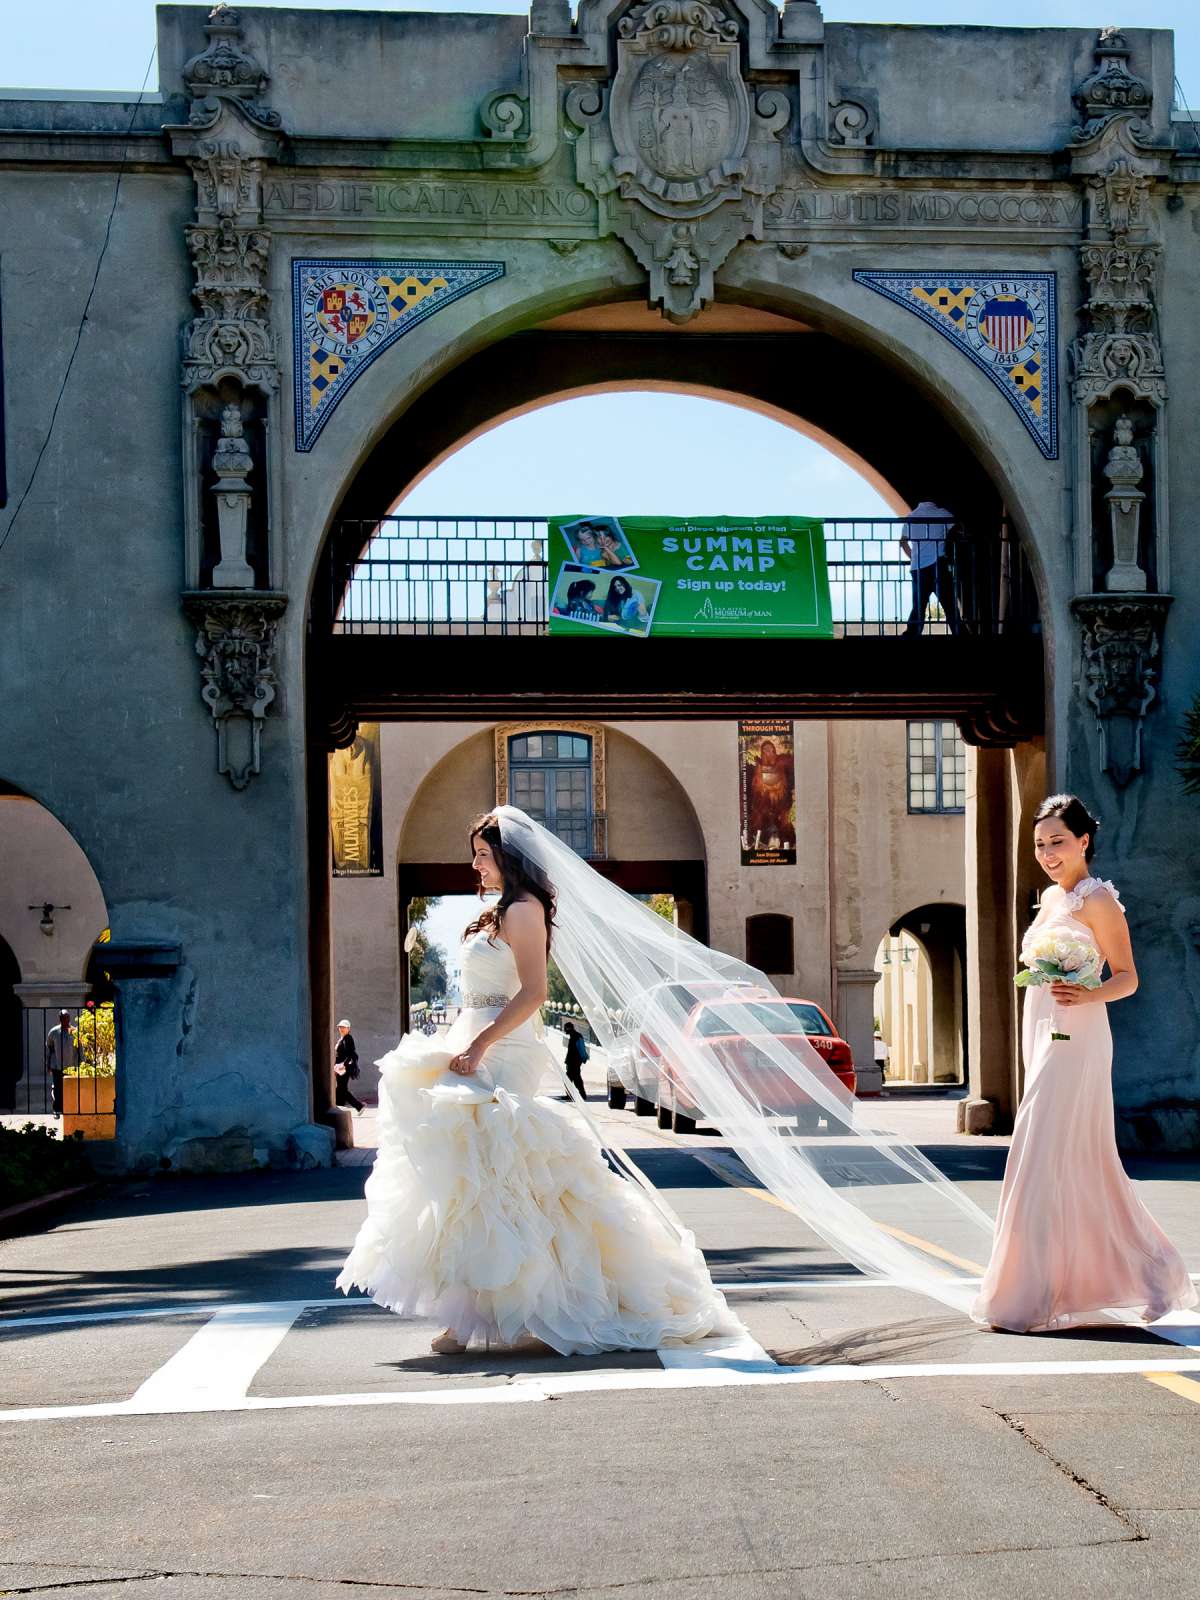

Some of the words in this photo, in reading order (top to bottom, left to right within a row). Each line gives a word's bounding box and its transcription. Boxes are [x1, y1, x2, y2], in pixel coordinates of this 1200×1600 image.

[265, 182, 481, 214] AEDIFICATA
[488, 187, 592, 217] ANNO
[765, 192, 901, 222] SALUTIS
[906, 195, 1082, 223] MDCCCCXV
[305, 274, 335, 306] ORBIS
[340, 271, 369, 287] NON
[993, 353, 1019, 364] 1848
[662, 536, 796, 554] SUMMER
[686, 555, 775, 572] CAMP
[677, 579, 711, 591] Sign
[714, 581, 734, 592] up
[738, 579, 786, 592] today!
[344, 786, 360, 861] MUMMIES
[813, 1039, 833, 1050] 340
